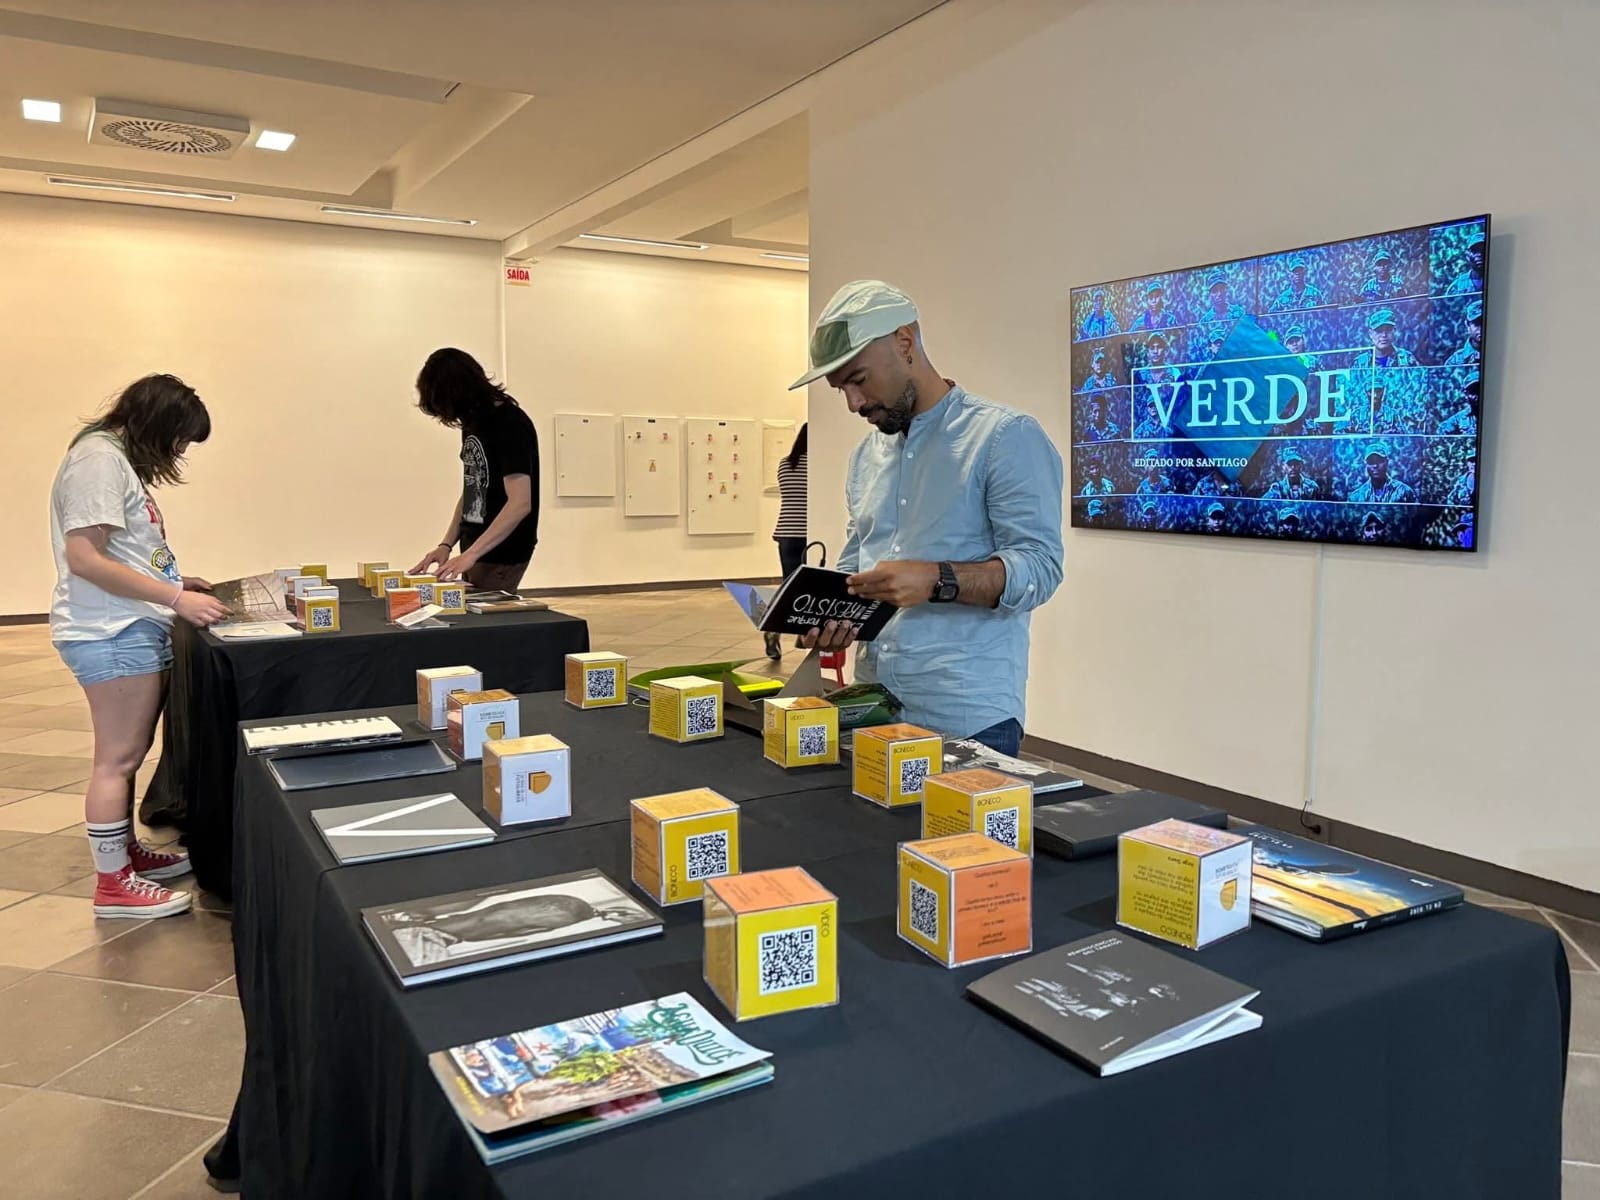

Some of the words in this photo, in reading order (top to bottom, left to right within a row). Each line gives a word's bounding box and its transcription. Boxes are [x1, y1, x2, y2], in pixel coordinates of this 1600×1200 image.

[506, 268, 530, 280] SAÍDA
[1146, 369, 1352, 429] VERDE
[1134, 458, 1174, 468] EDITADO
[1176, 458, 1194, 468] POR
[1196, 457, 1248, 468] SANTIAGO
[793, 594, 862, 619] RESISTO
